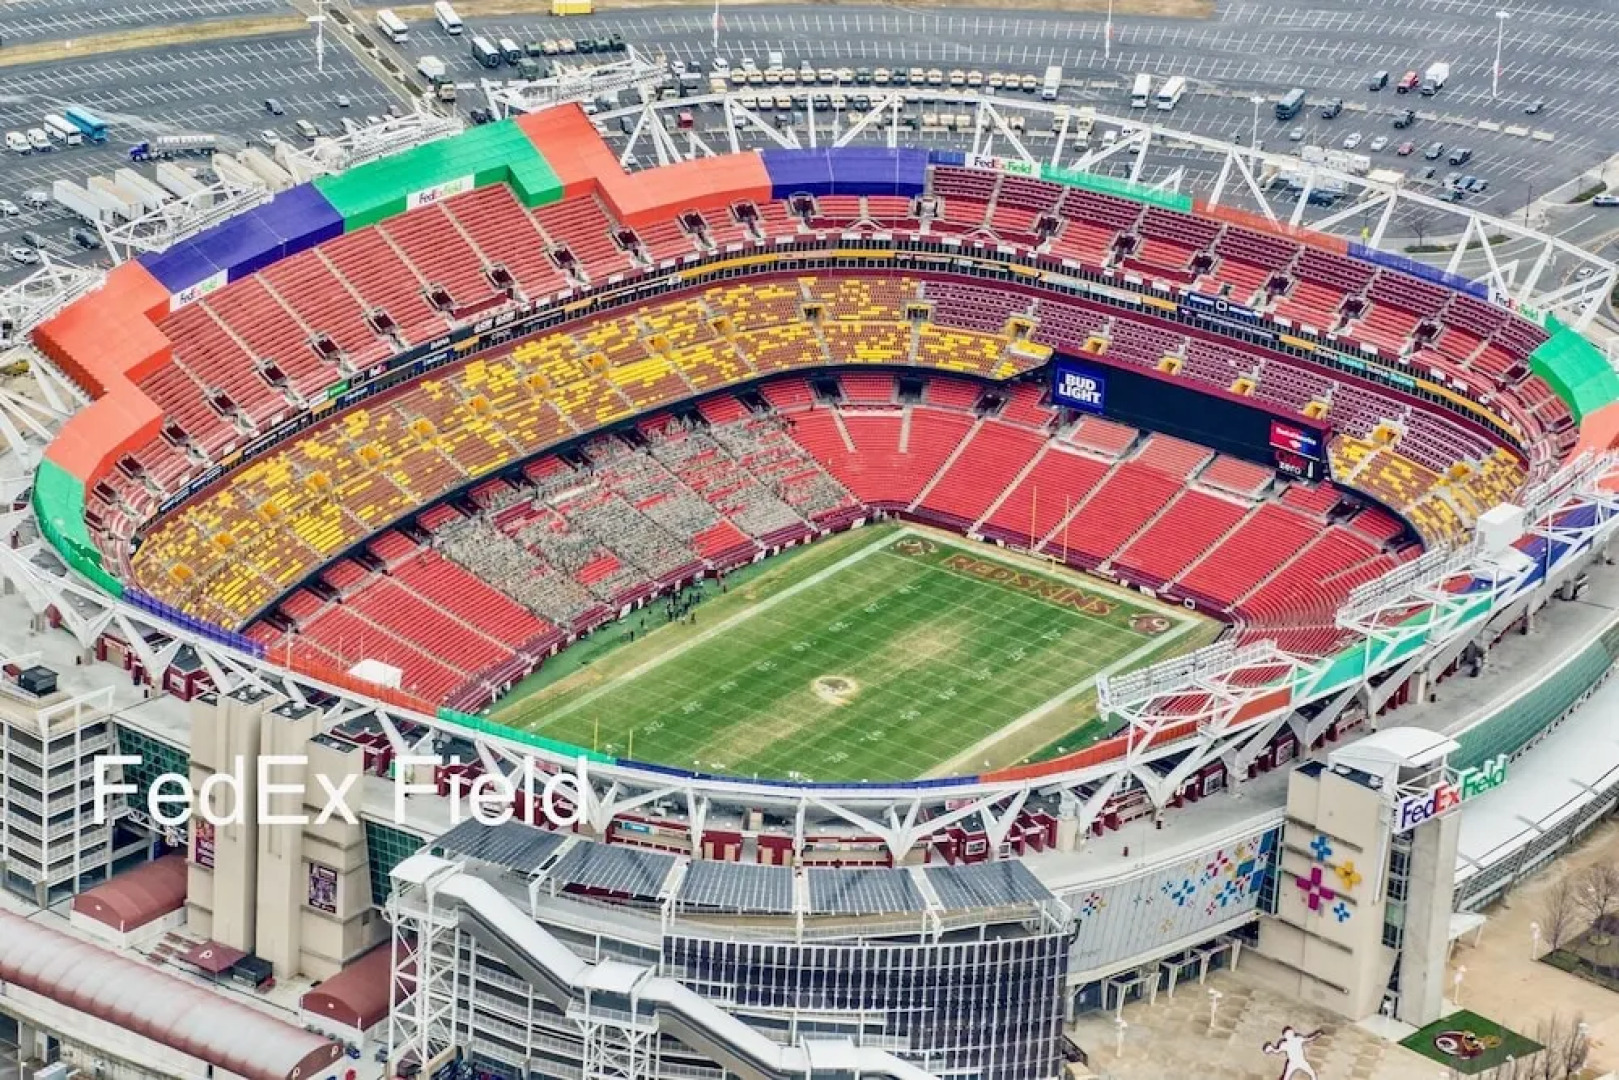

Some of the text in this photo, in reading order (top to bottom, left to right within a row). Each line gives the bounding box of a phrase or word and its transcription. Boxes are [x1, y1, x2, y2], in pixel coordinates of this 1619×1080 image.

[1058, 382, 1102, 404] LIGHT
[1064, 373, 1097, 391] BUD
[939, 553, 1119, 616] REDSKINS
